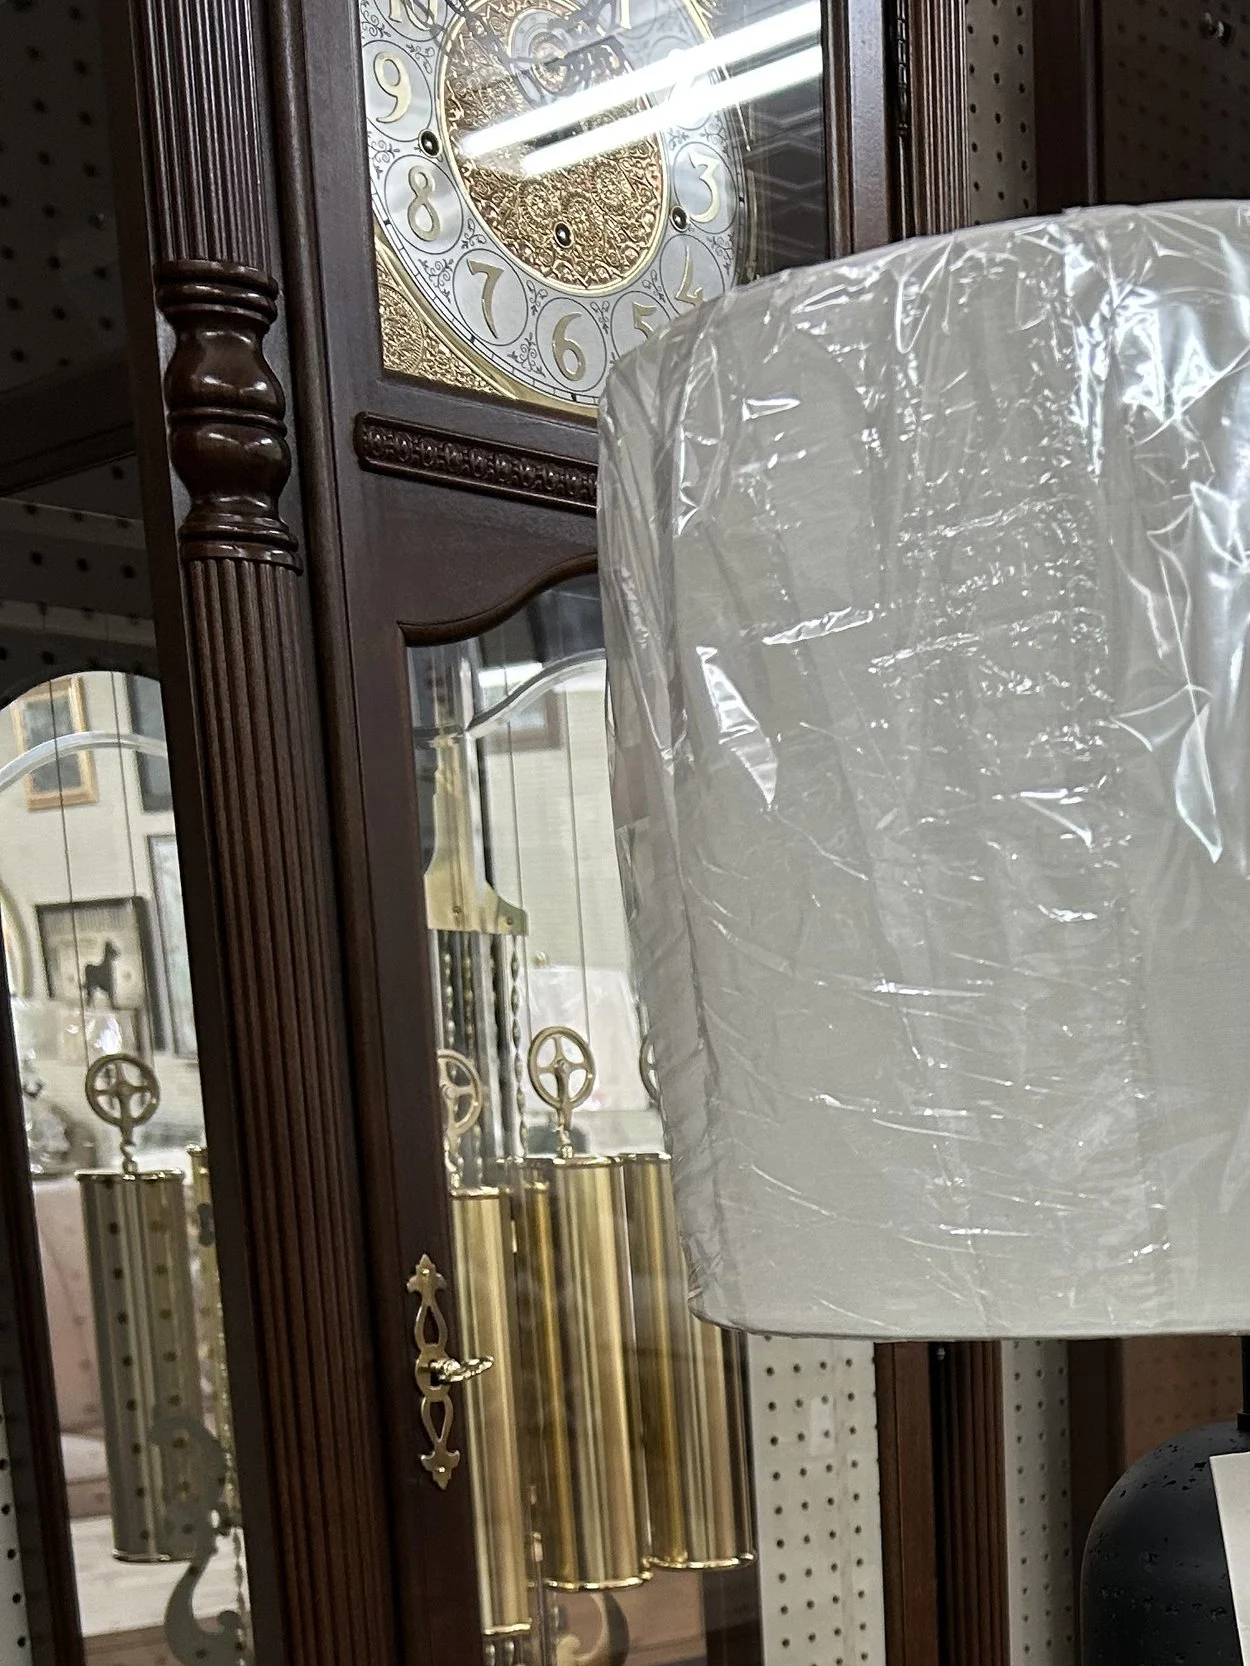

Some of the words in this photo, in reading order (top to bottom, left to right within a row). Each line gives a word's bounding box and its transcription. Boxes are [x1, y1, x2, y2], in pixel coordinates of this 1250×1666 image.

[373, 51, 412, 124] 9
[407, 165, 441, 242] 8
[687, 152, 720, 224] 3
[467, 258, 505, 339] 7
[551, 311, 587, 382] 6
